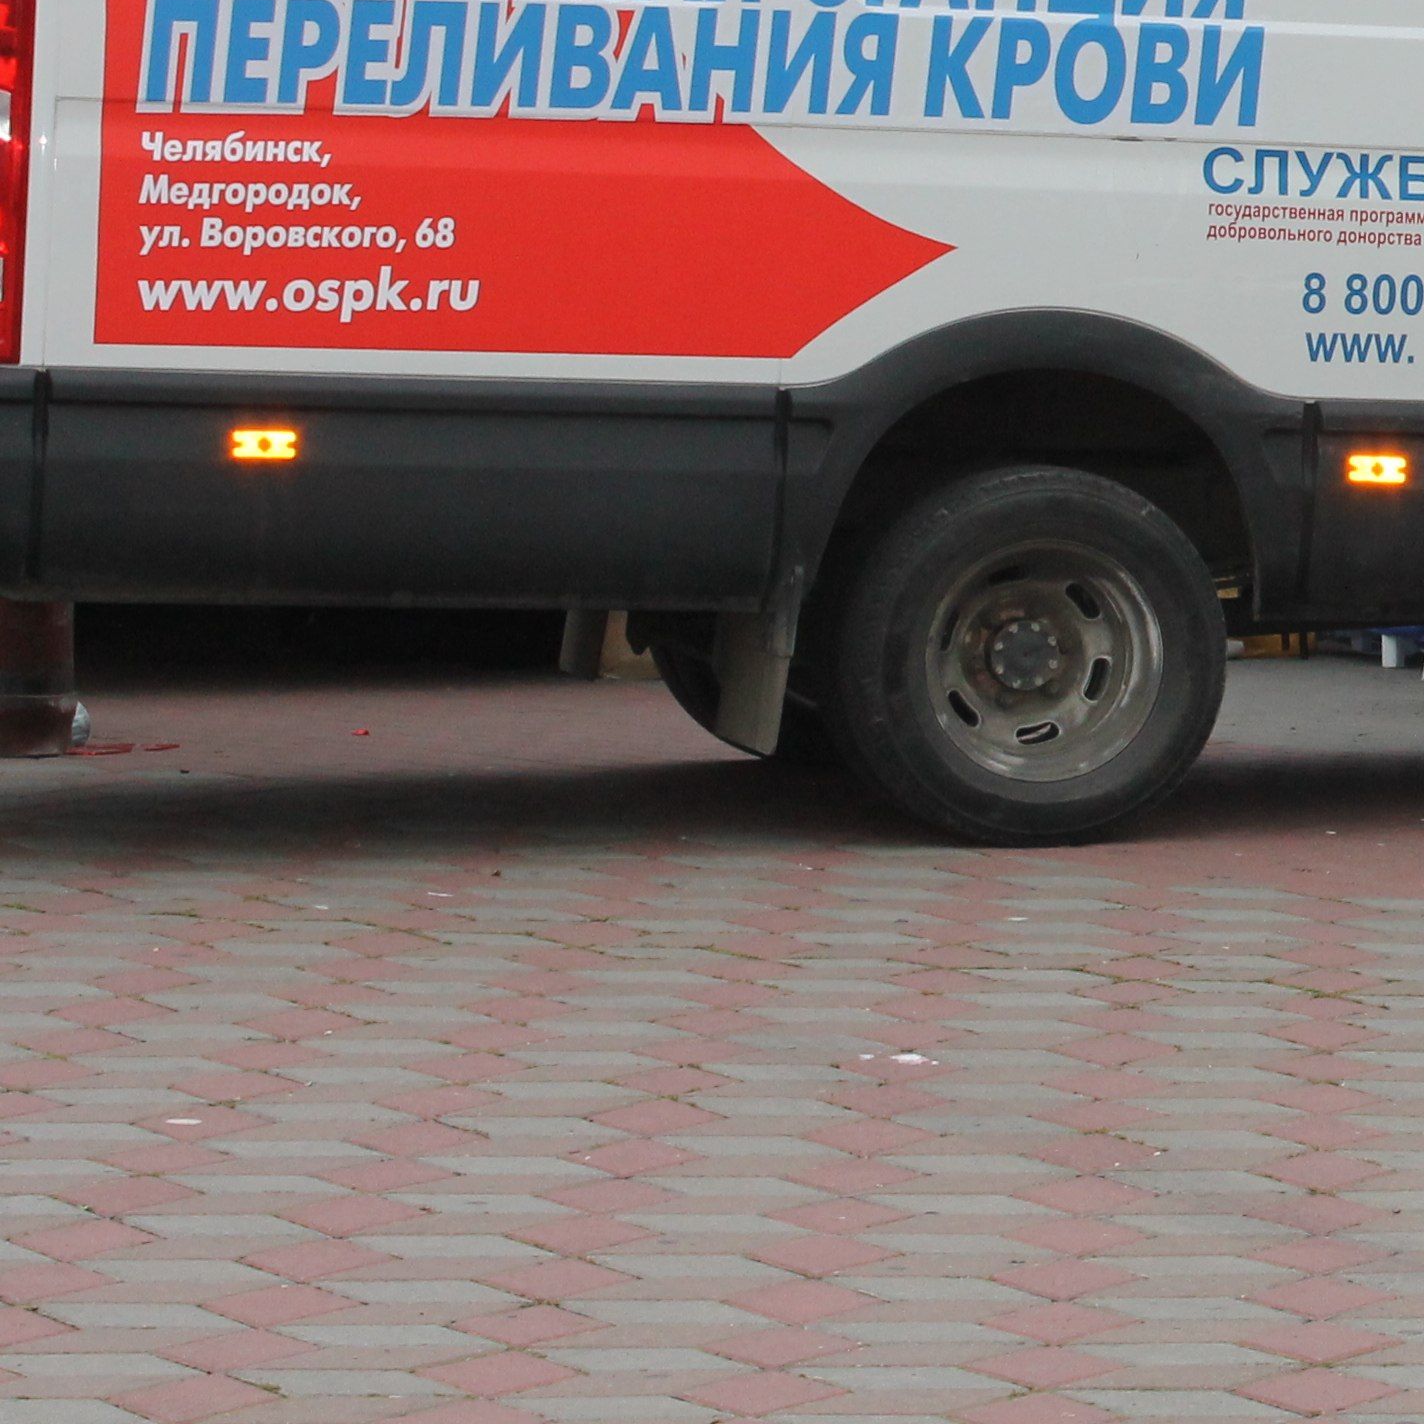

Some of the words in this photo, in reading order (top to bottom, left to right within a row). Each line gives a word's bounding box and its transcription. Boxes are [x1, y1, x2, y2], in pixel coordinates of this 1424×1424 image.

[922, 13, 1266, 127] КРОВИ
[140, 130, 333, 168] Челябинск,
[137, 173, 362, 212] Медгородок,
[1207, 203, 1345, 222] государственная
[138, 222, 191, 255] ул.
[200, 217, 407, 254] Воровского,
[414, 217, 456, 248] 68
[1206, 222, 1333, 244] добровольного
[1336, 229, 1422, 248] донорства
[137, 265, 481, 324] www.ospk.ru
[1302, 272, 1327, 314] 8
[1344, 272, 1424, 316] 800
